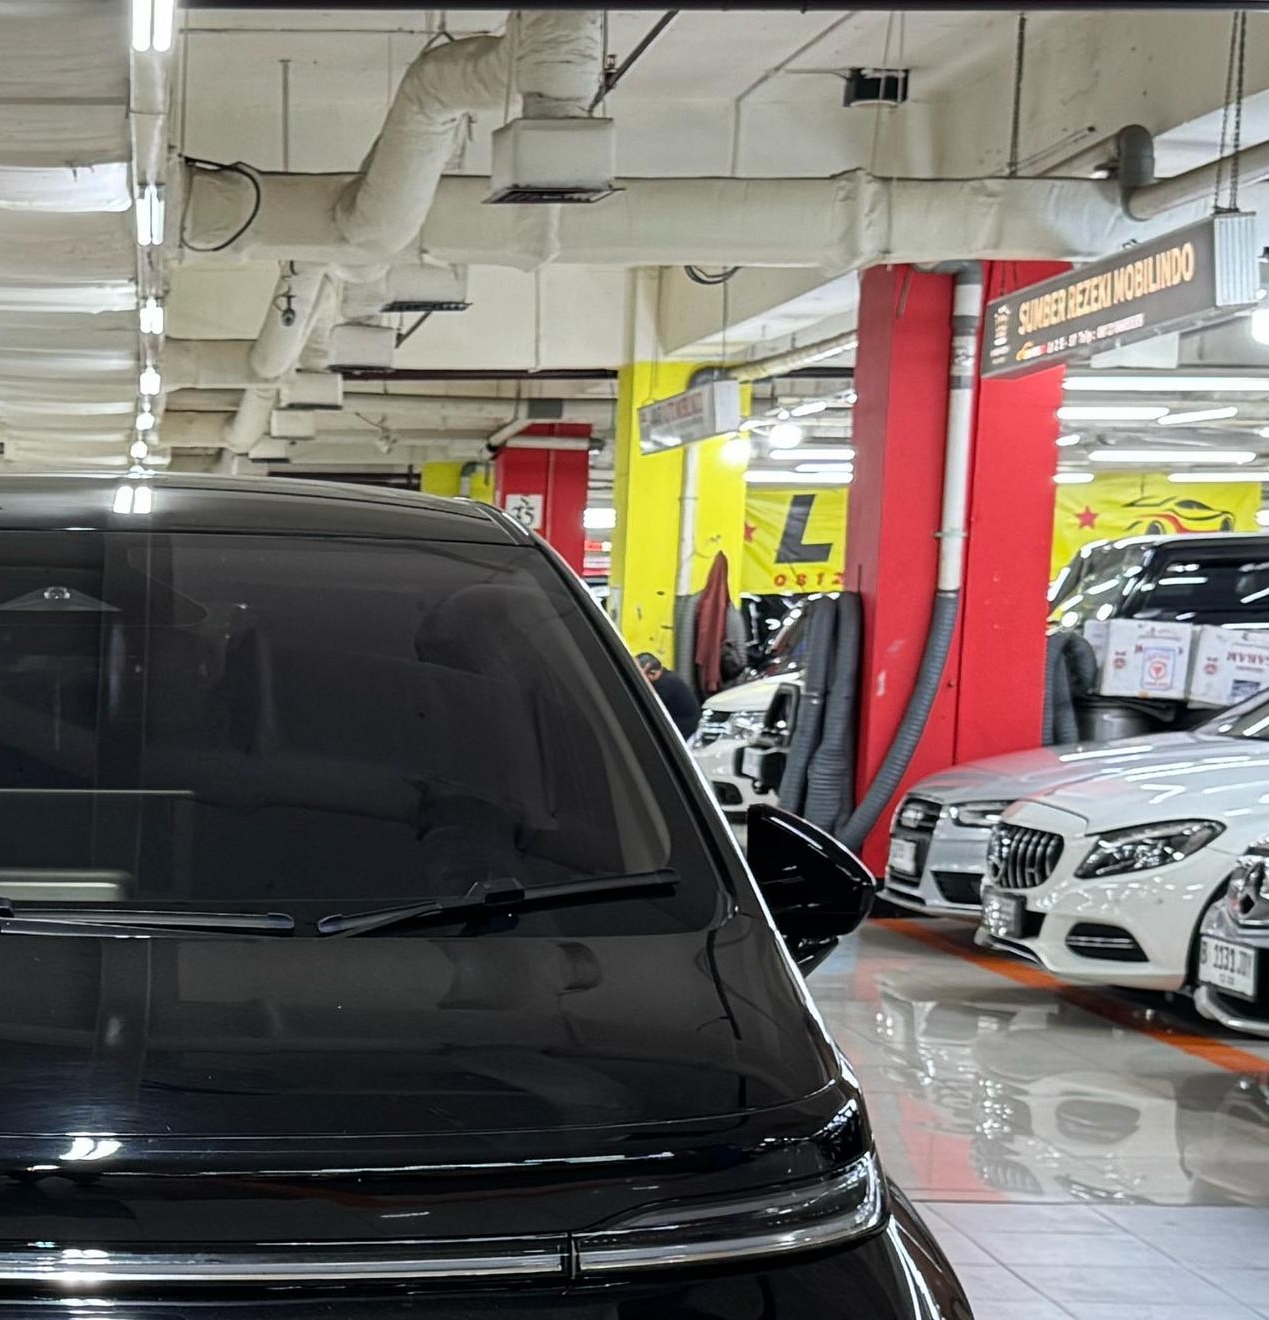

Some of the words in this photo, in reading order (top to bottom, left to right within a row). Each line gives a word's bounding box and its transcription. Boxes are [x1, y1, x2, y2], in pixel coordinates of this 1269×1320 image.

[1017, 288, 1067, 336] SUMBER
[1067, 270, 1113, 320] REZEKI
[1113, 240, 1195, 305] MOBILINDO
[774, 494, 833, 564] L
